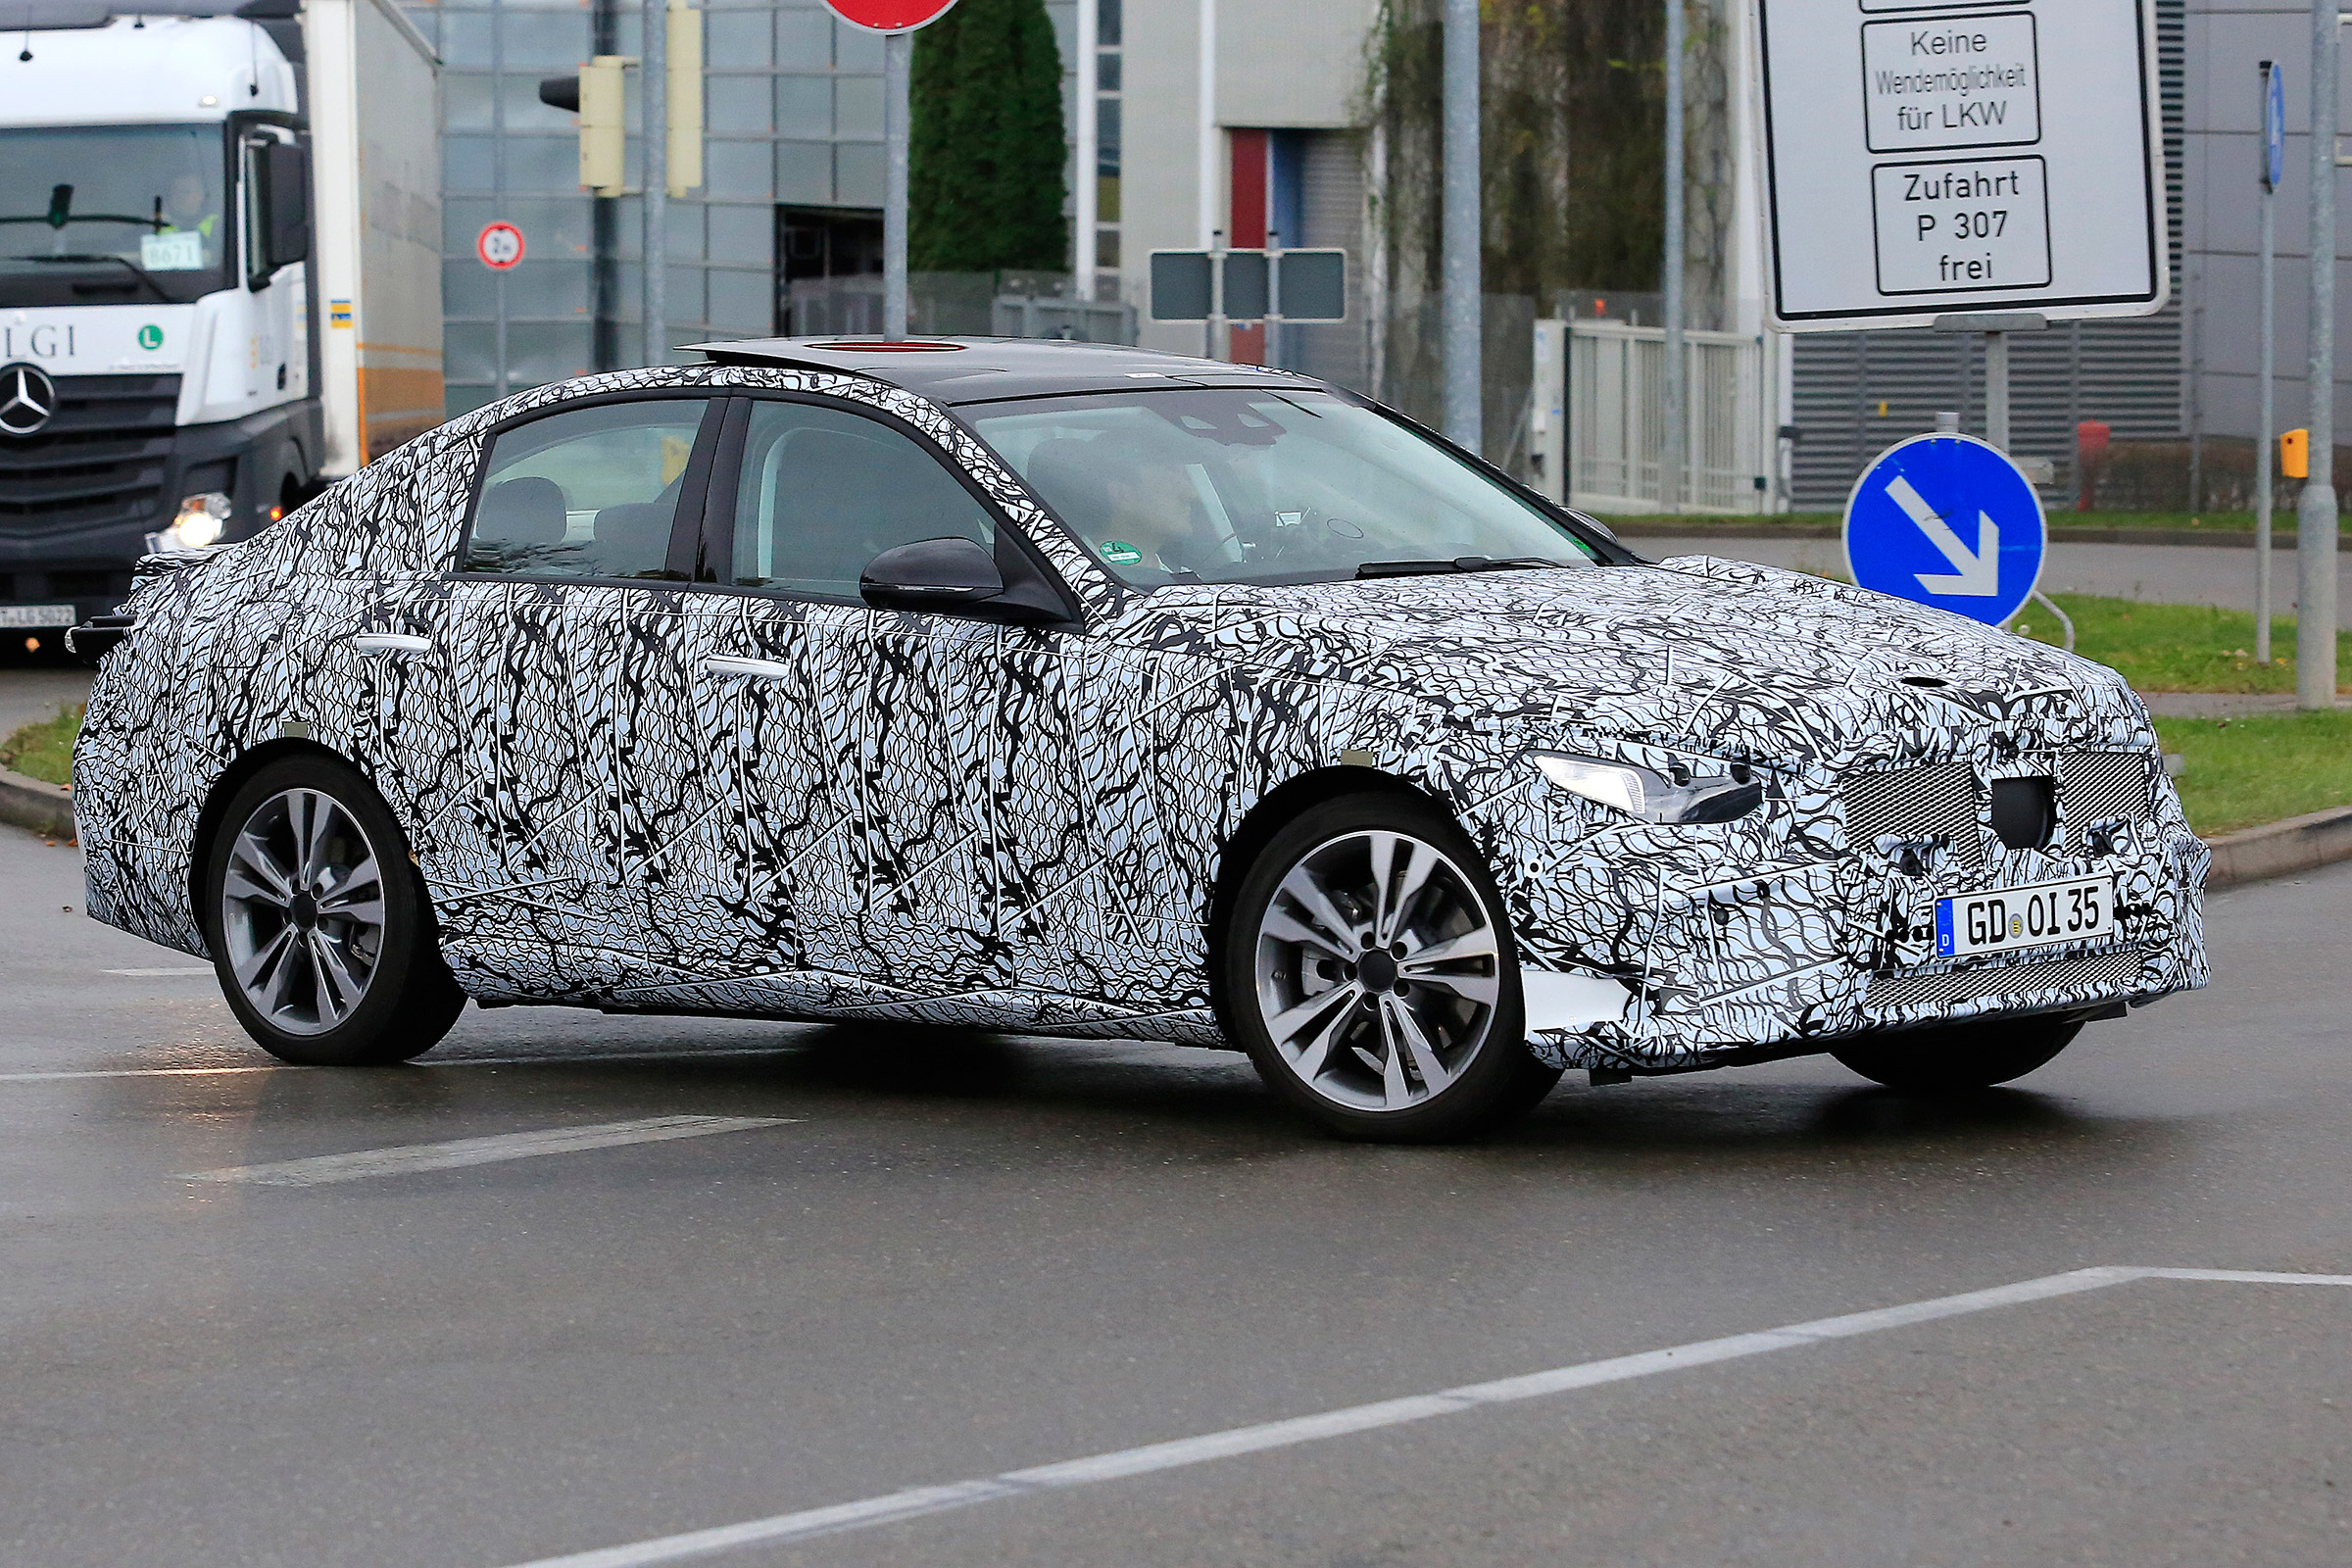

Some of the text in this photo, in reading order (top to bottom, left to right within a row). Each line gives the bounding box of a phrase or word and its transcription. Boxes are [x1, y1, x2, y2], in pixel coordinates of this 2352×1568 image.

[1911, 29, 1986, 55] Keine
[1876, 63, 2027, 96] Wendemöglichkeit
[1897, 101, 2007, 130] für LKW
[1904, 171, 2019, 202] Zufahrt
[1918, 211, 2007, 241] P 307
[1939, 253, 1991, 281] frei
[5, 324, 74, 359] LGI
[1941, 934, 1950, 947] D
[1967, 899, 2006, 945] GD
[2067, 886, 2099, 931] 35
